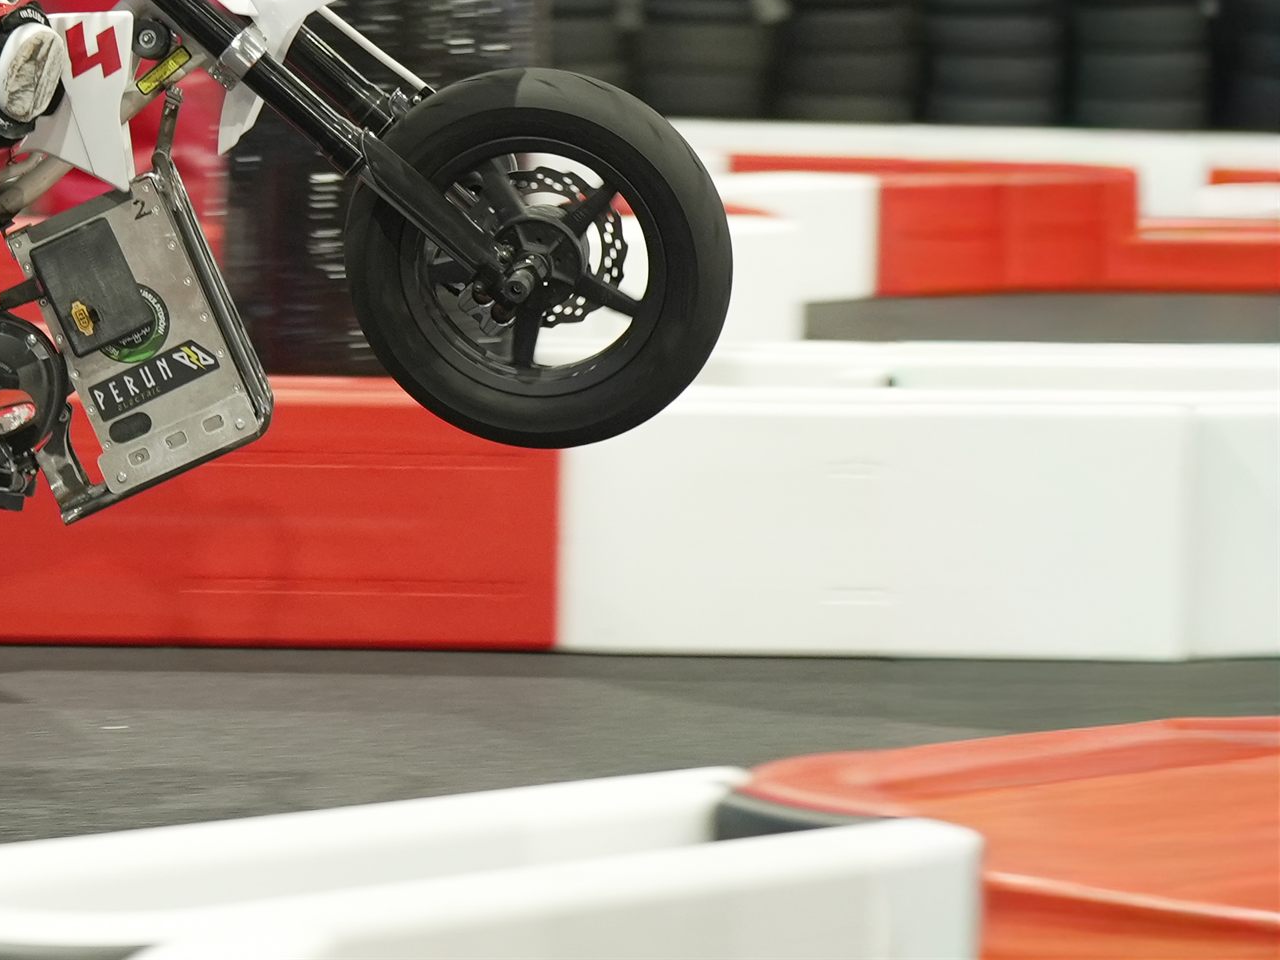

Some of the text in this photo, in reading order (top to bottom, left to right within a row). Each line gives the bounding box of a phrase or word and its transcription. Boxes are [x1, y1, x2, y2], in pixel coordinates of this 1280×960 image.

[65, 20, 122, 80] 4
[132, 199, 153, 221] 2
[93, 357, 174, 411] PERUN
